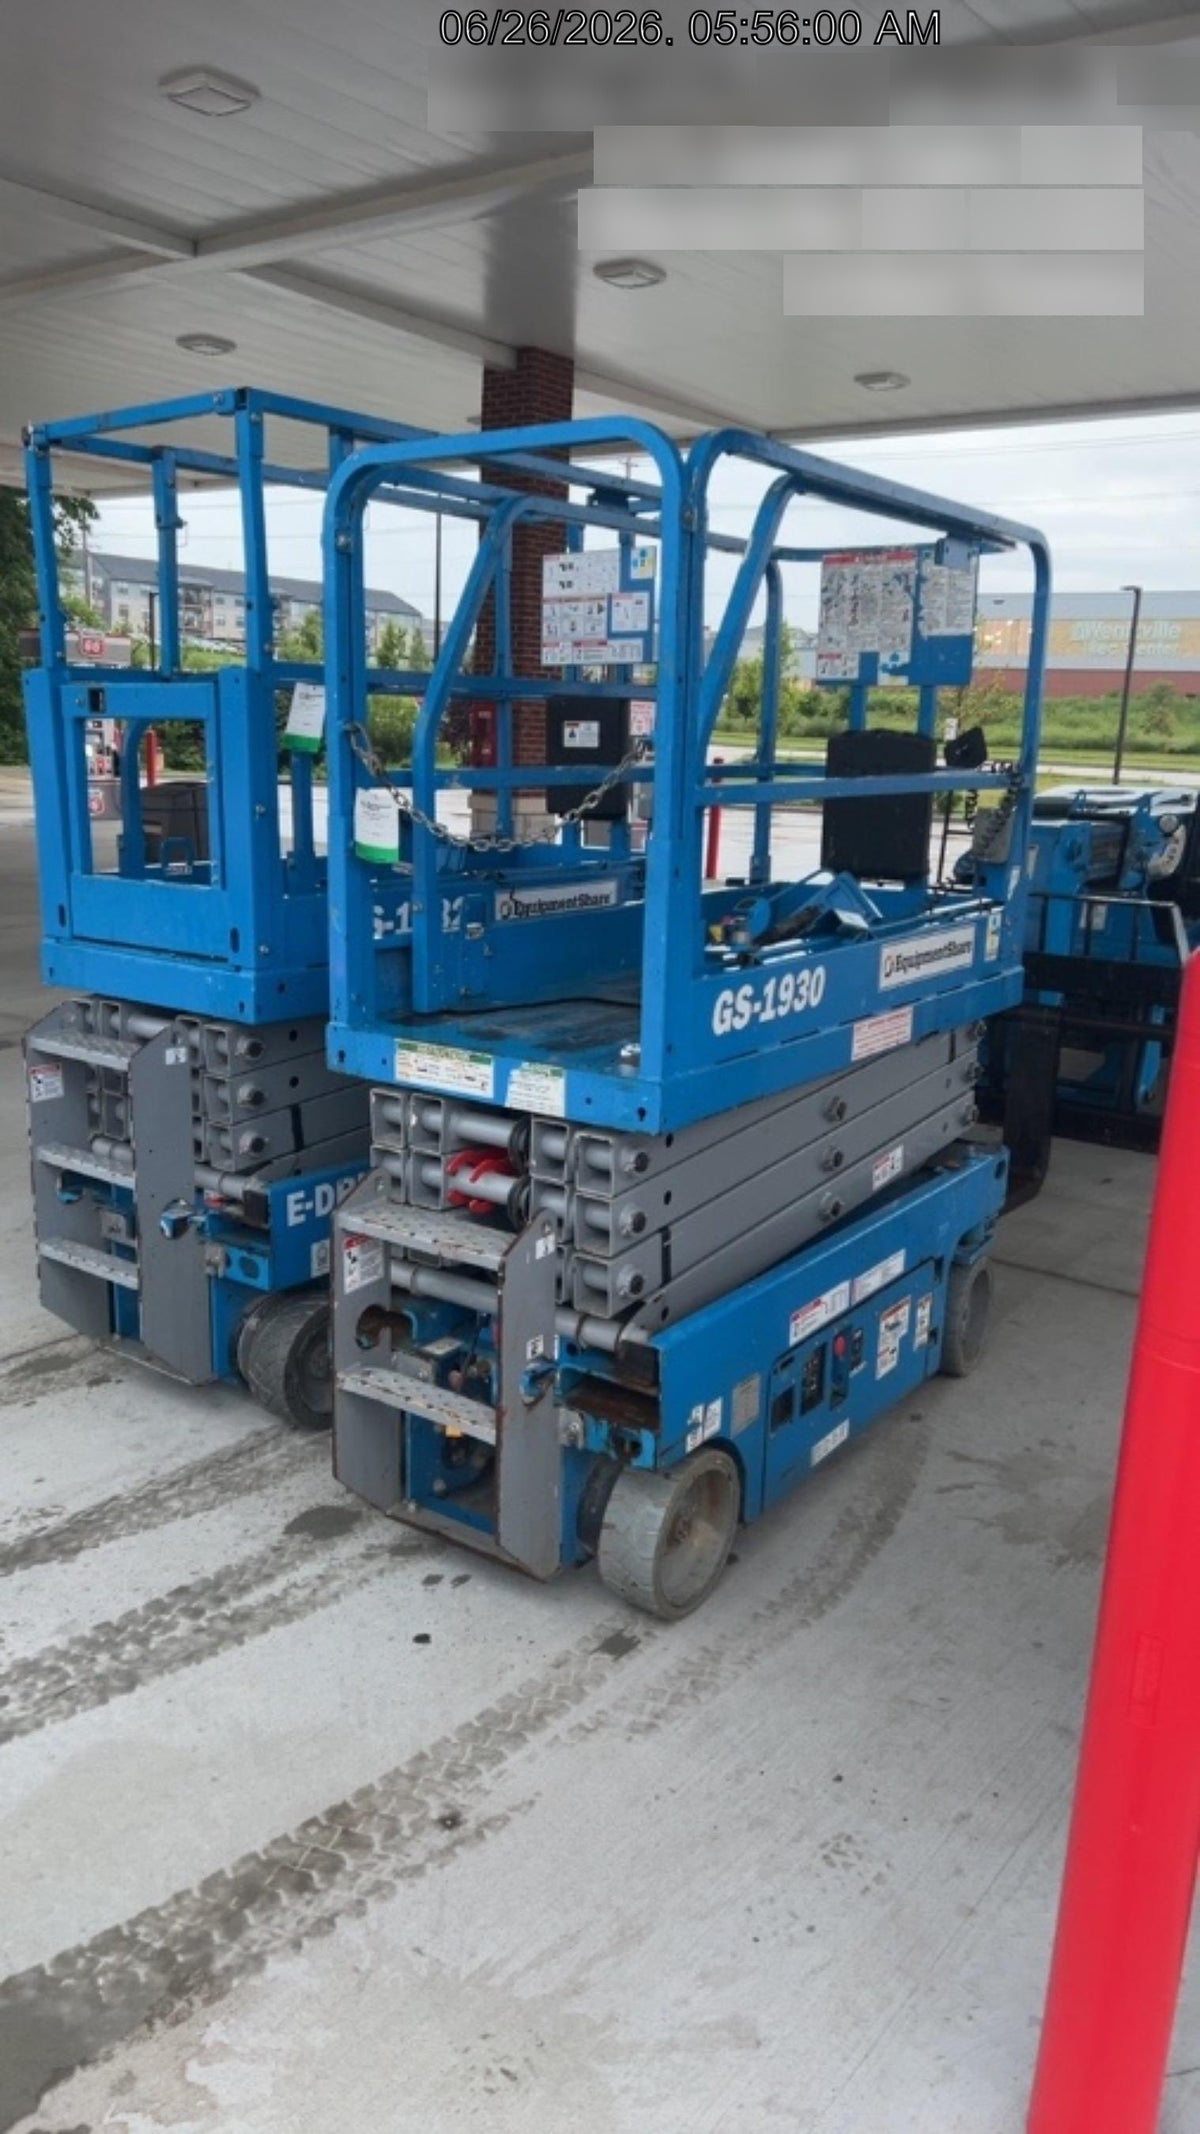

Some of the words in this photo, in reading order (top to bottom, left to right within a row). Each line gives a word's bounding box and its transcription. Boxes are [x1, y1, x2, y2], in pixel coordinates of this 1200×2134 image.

[514, 892, 611, 918] EquipmentShare
[895, 940, 972, 974] EquipmentShare
[712, 965, 826, 1036] GS-1930
